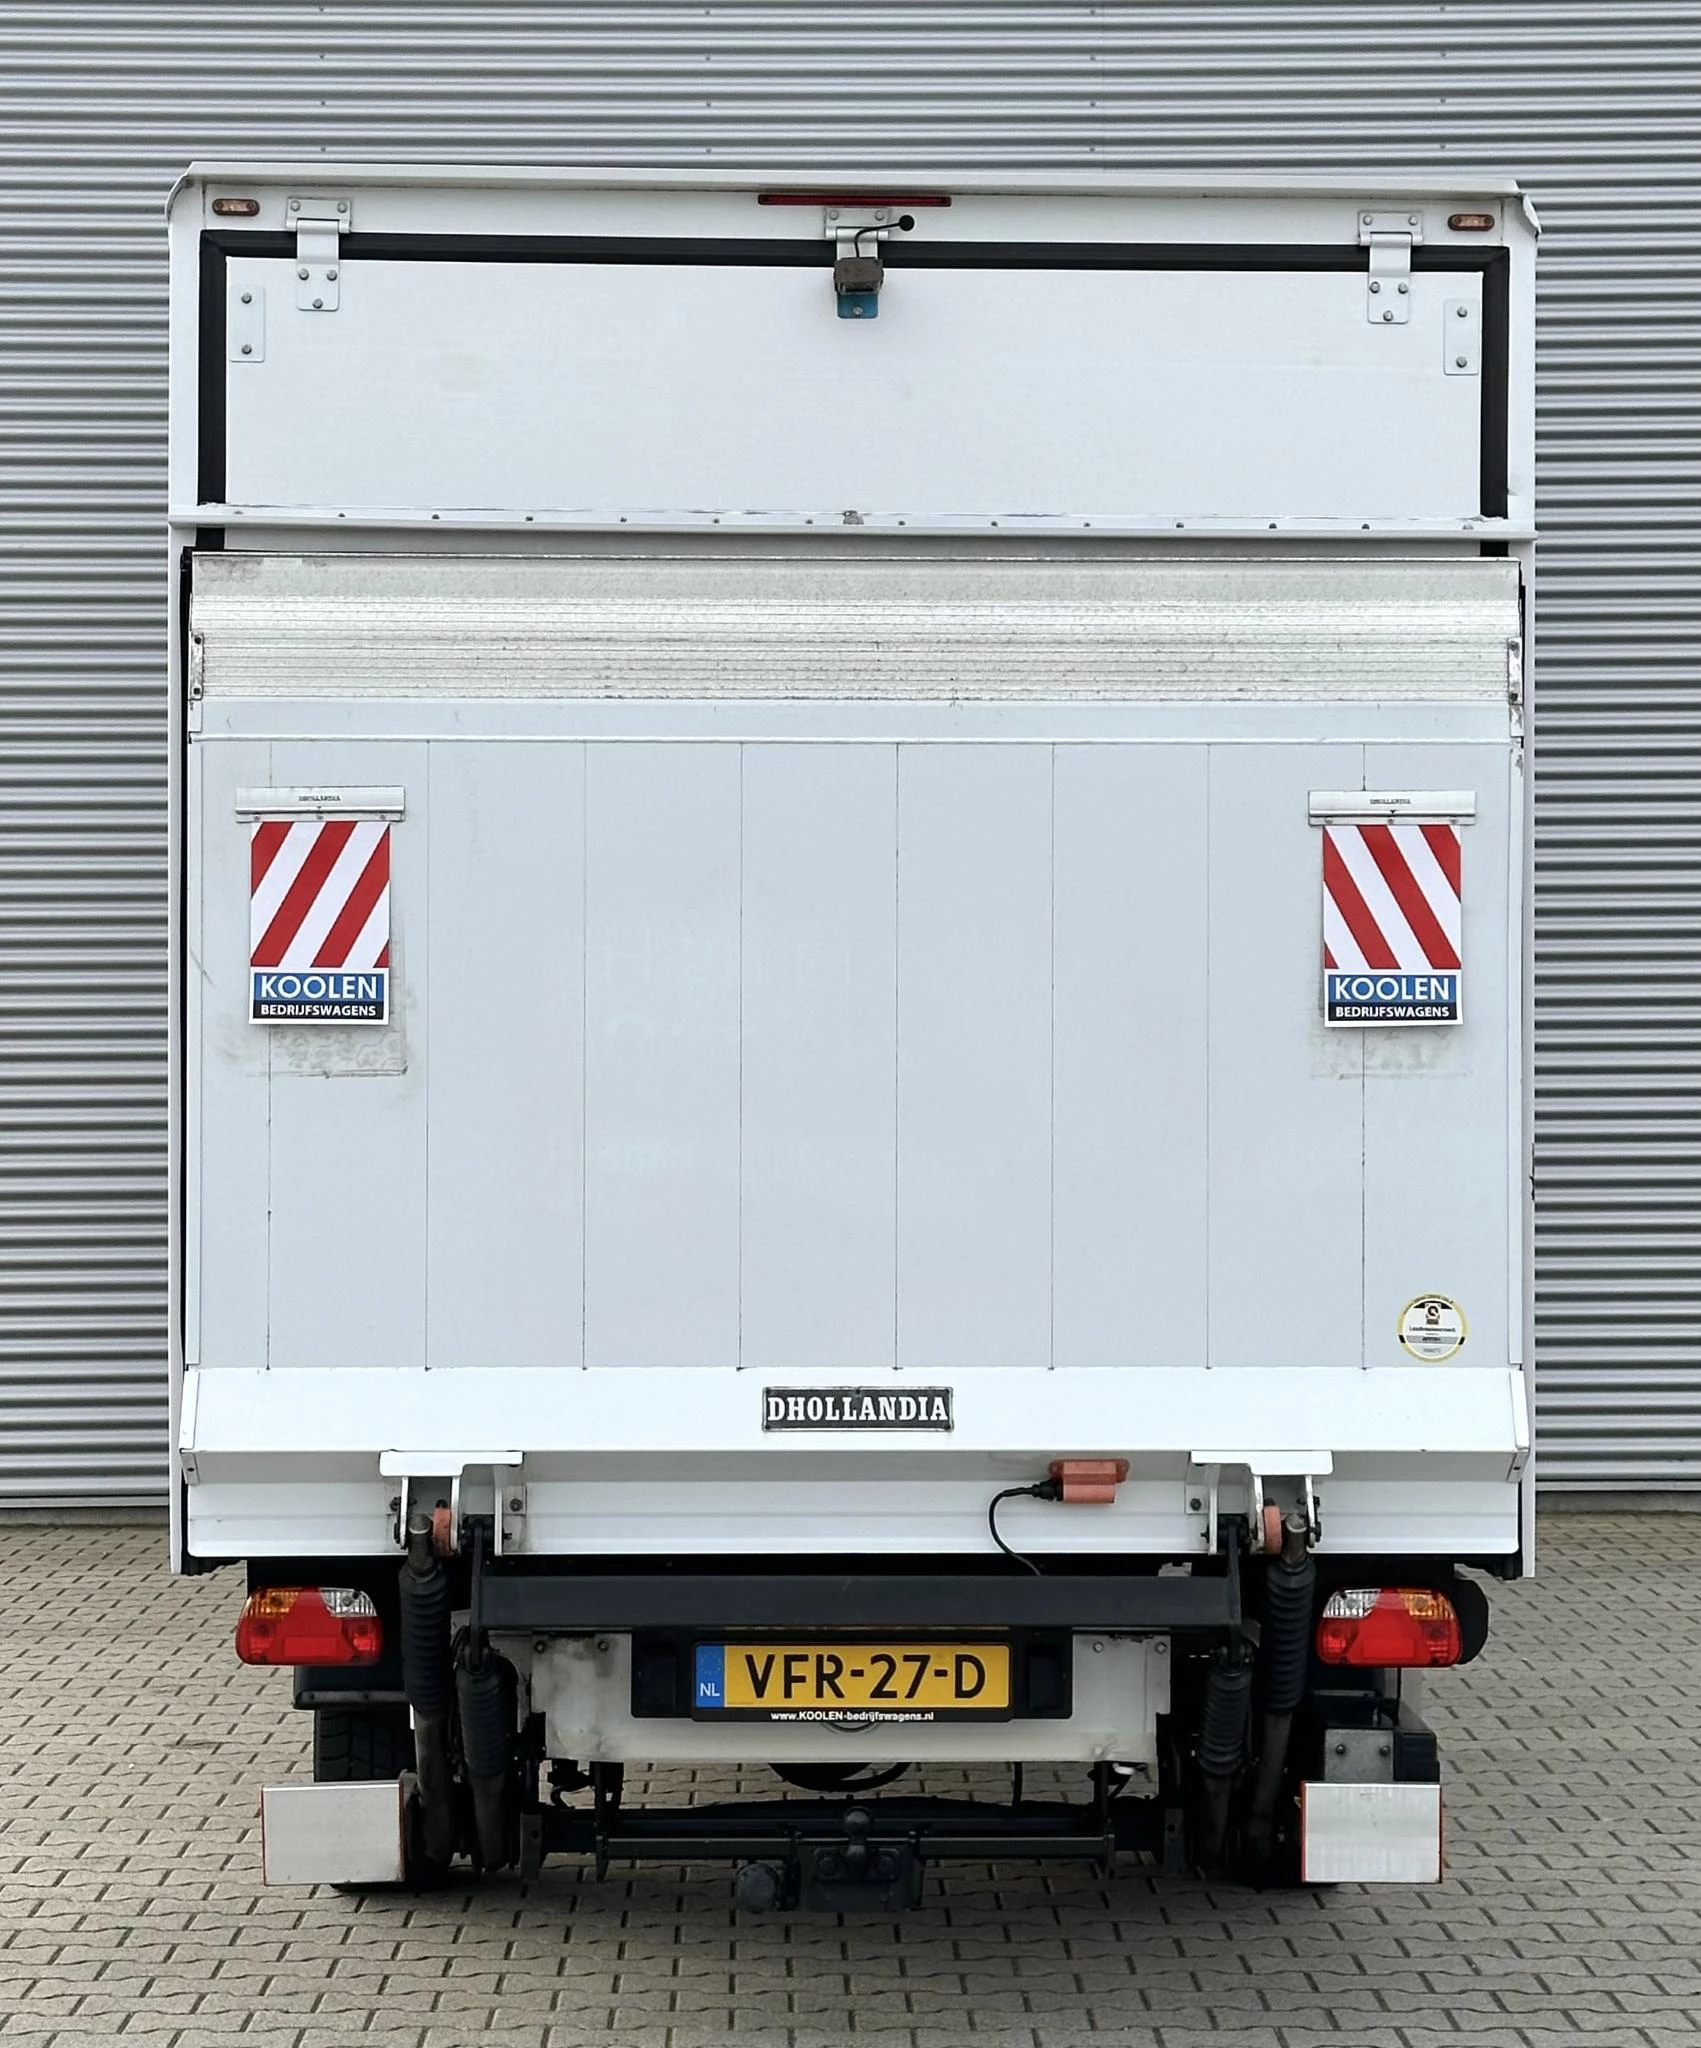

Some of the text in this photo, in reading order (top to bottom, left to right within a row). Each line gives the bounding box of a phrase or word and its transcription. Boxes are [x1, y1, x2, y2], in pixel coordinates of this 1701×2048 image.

[260, 975, 377, 1000] KOOLEN
[1335, 976, 1450, 1001] KOOLEN
[260, 1003, 377, 1017] BEDRIJFSWAGENS
[1335, 1005, 1450, 1018] BEDRIJFSWAGENS
[767, 1396, 948, 1421] DHOLLANDIA
[745, 1653, 986, 1699] VFR-27-D
[700, 1682, 721, 1697] NL
[770, 1710, 934, 1722] www.KOOLEN-bedrijfswagens.nl
